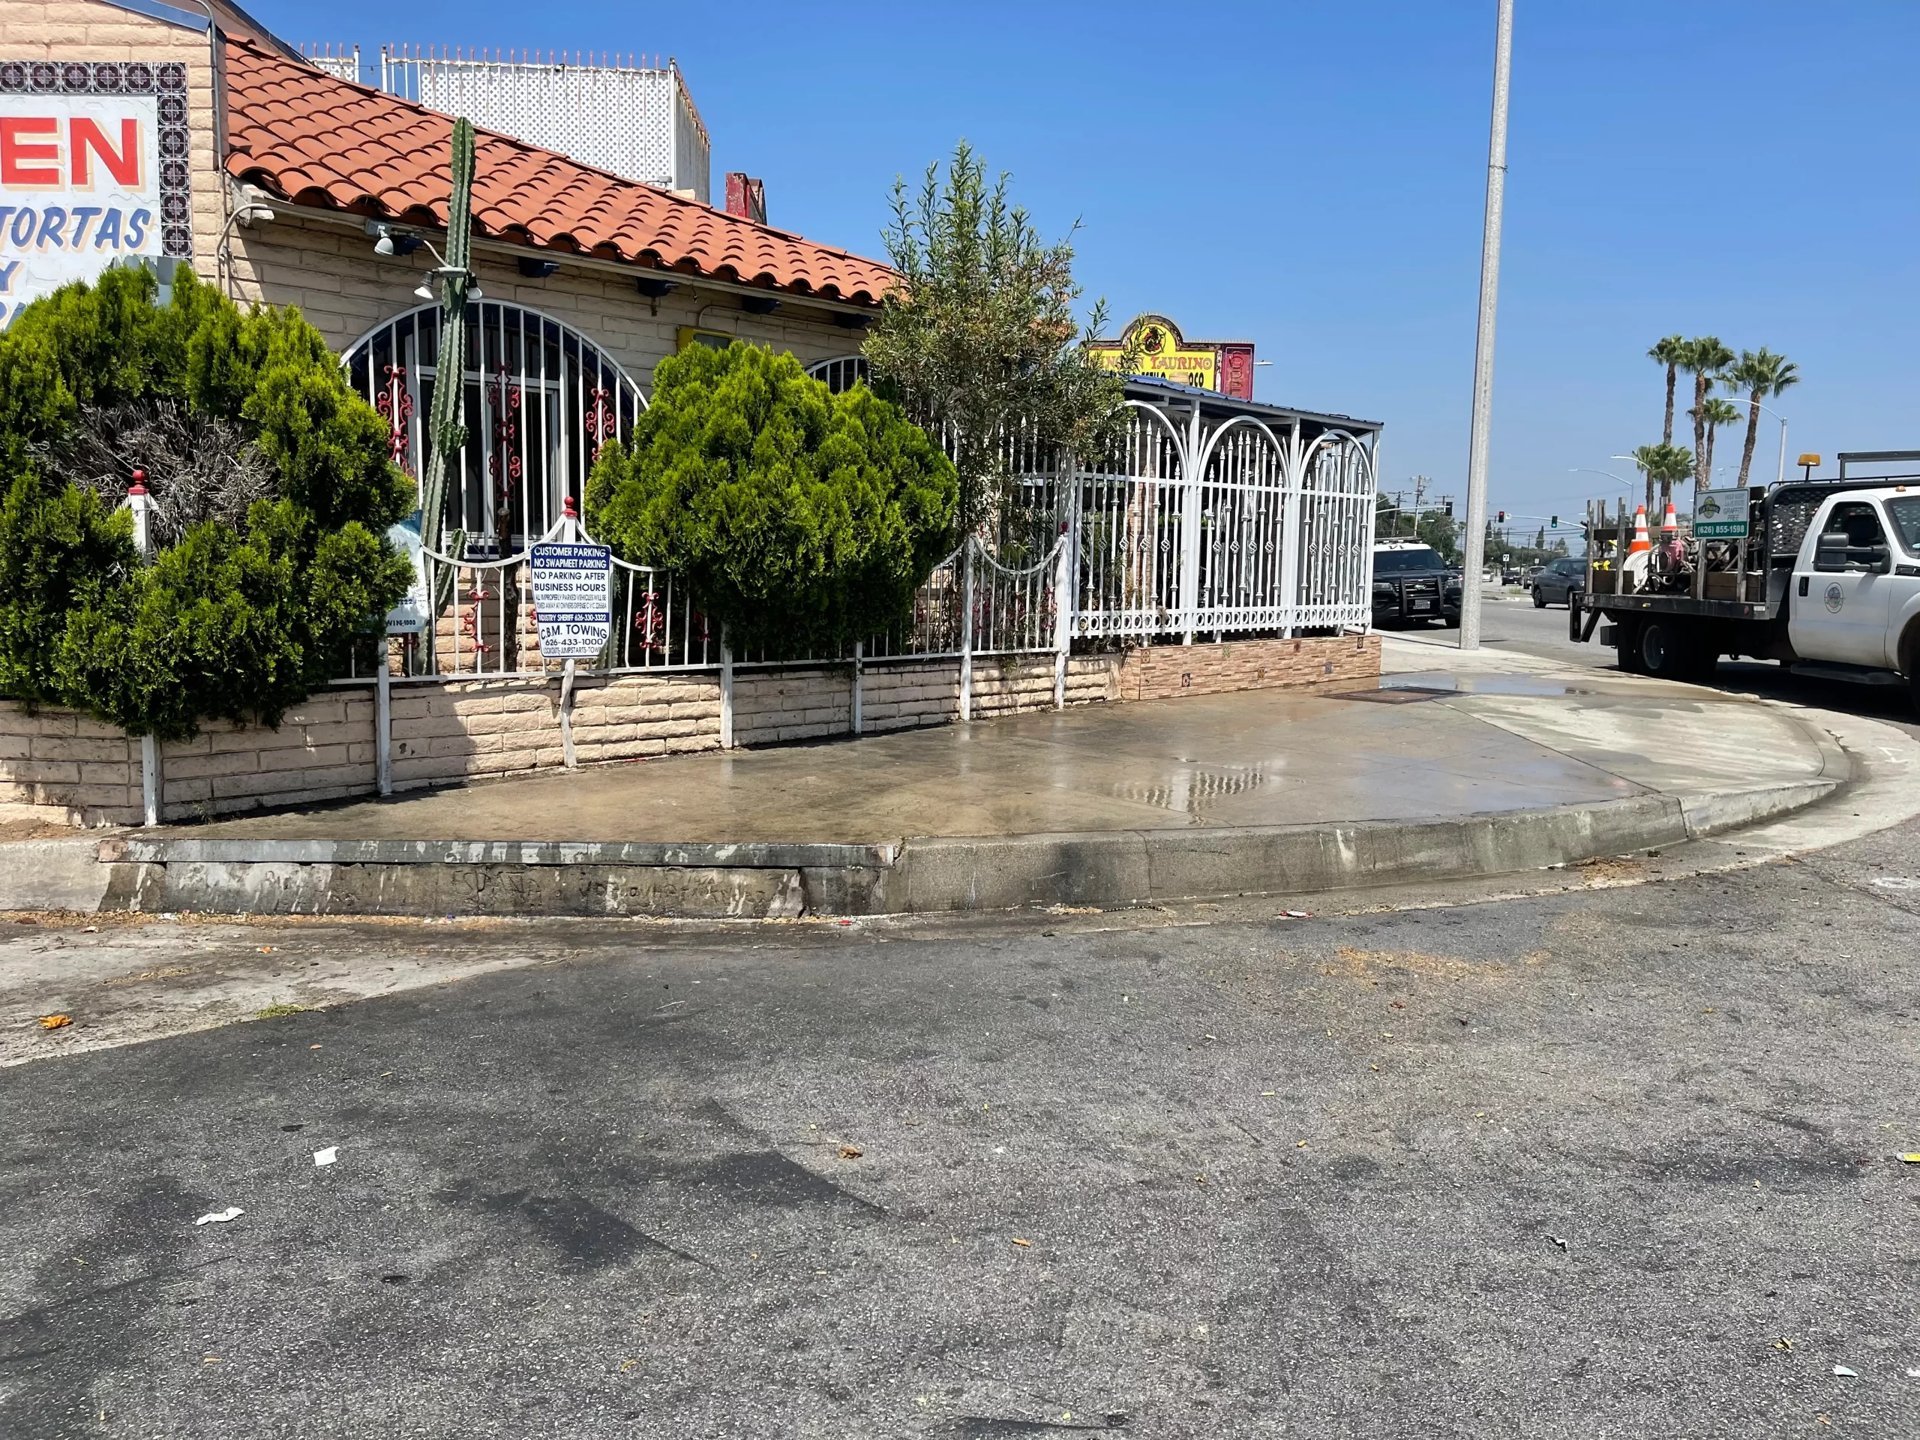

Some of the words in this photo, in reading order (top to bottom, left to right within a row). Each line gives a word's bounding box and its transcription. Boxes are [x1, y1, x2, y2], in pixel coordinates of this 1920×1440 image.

[1149, 356, 1213, 370] TAURINO
[1697, 525, 1714, 535] (626)
[534, 546, 573, 556] CUSTOMER
[573, 547, 607, 558] PARKING
[533, 558, 545, 568] NO
[545, 558, 578, 569] SWAPMEET
[578, 559, 607, 569] PARKING
[533, 571, 547, 580] NO
[548, 571, 582, 580] PARKING
[583, 572, 606, 581] AFTER
[534, 583, 573, 592] BUSINESS
[575, 583, 606, 592] HOURS
[566, 624, 608, 639] TOWING
[545, 638, 604, 646] 626-433-1000
